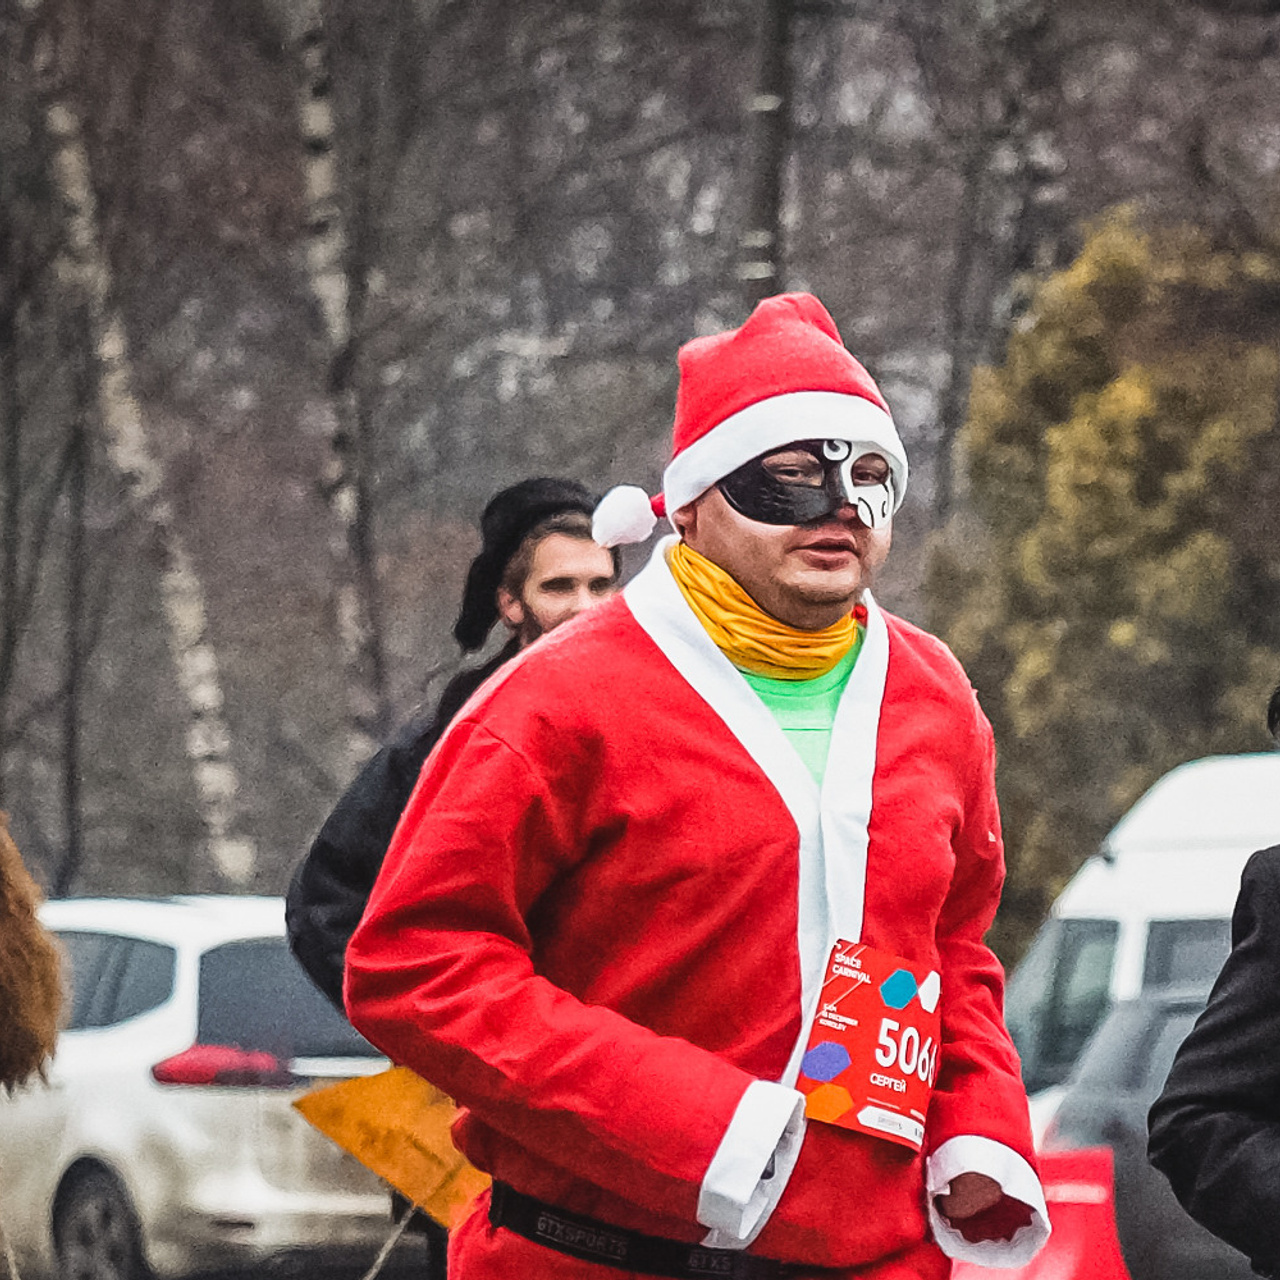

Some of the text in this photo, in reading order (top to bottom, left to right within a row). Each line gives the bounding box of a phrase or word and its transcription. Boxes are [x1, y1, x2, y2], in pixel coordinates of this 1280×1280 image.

[834, 953, 862, 968] SPACE
[832, 964, 871, 984] CARNIVAL
[870, 1073, 906, 1093] СЕРГЕЙ
